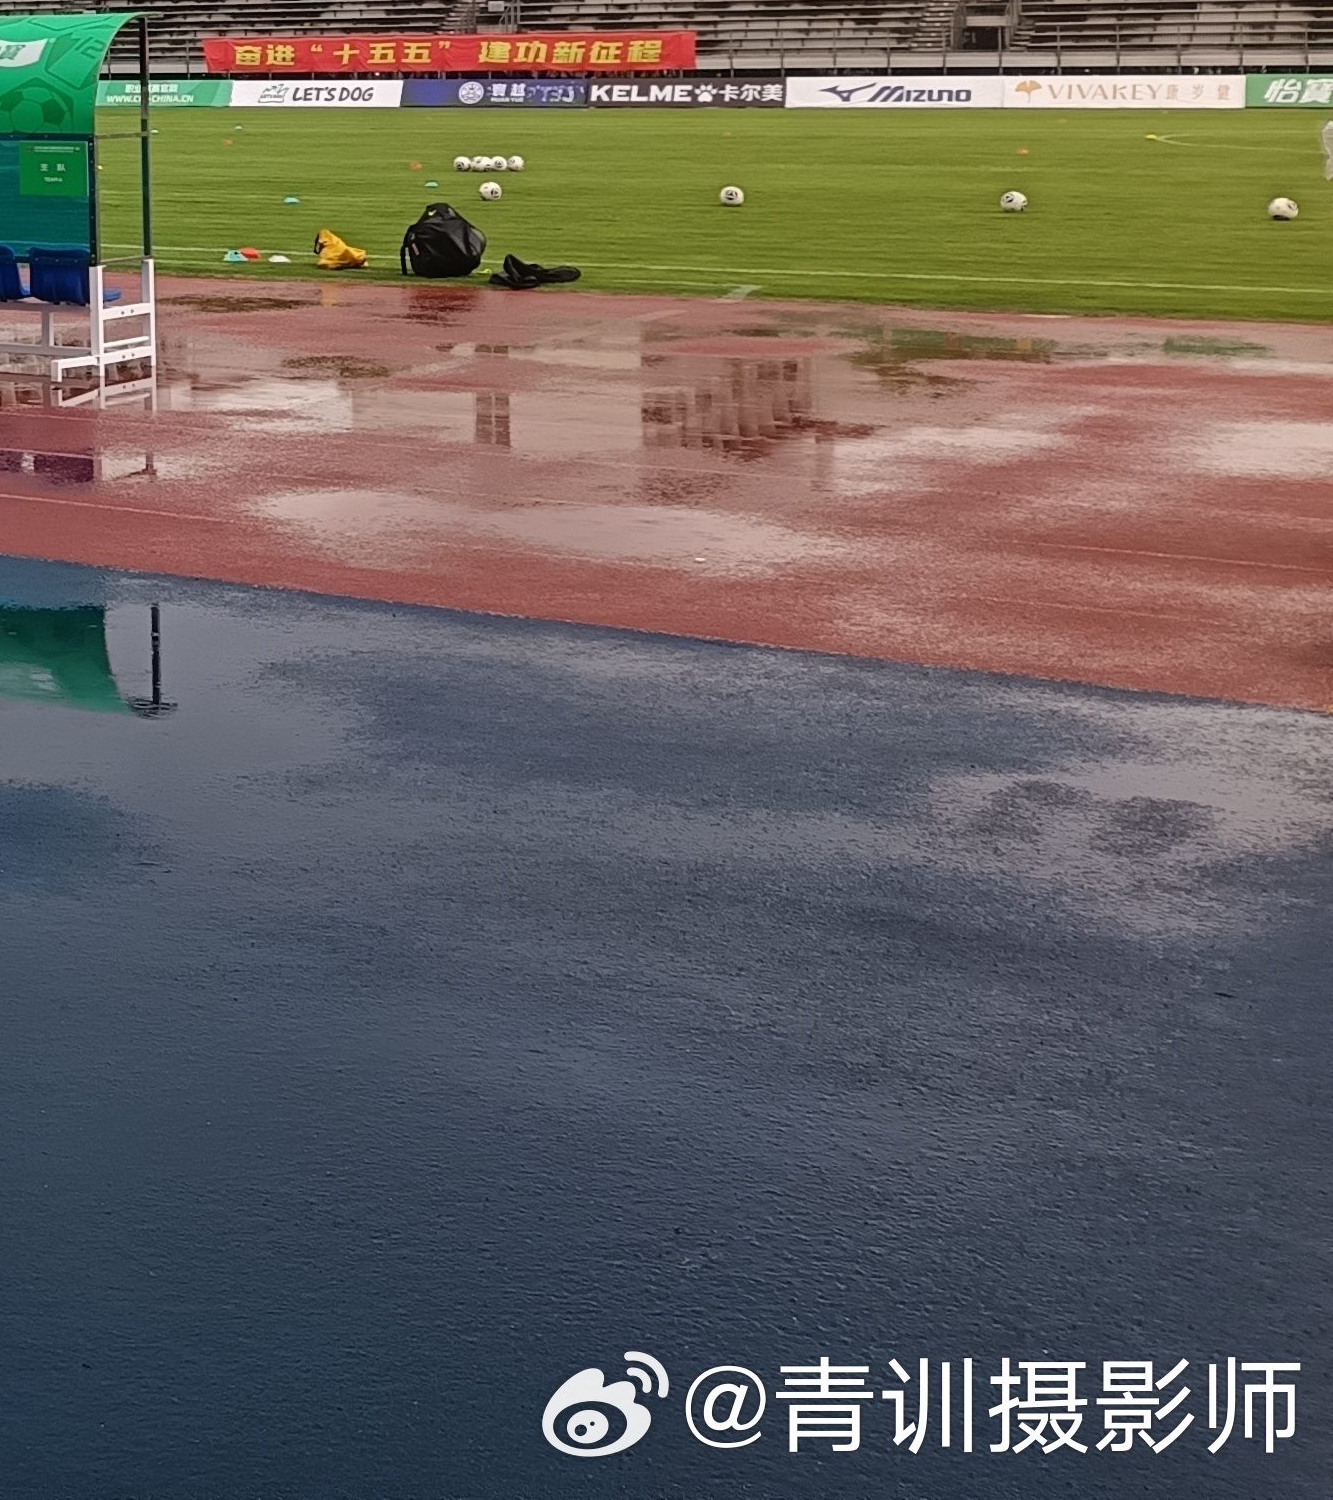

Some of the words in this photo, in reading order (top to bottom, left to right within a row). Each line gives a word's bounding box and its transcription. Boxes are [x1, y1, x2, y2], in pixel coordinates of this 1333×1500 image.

[292, 86, 336, 102] LET'S
[338, 86, 374, 102] DOG
[590, 84, 693, 102] KELME
[719, 84, 784, 102] 卡尔美
[1047, 83, 1162, 100] VIVAKEY
